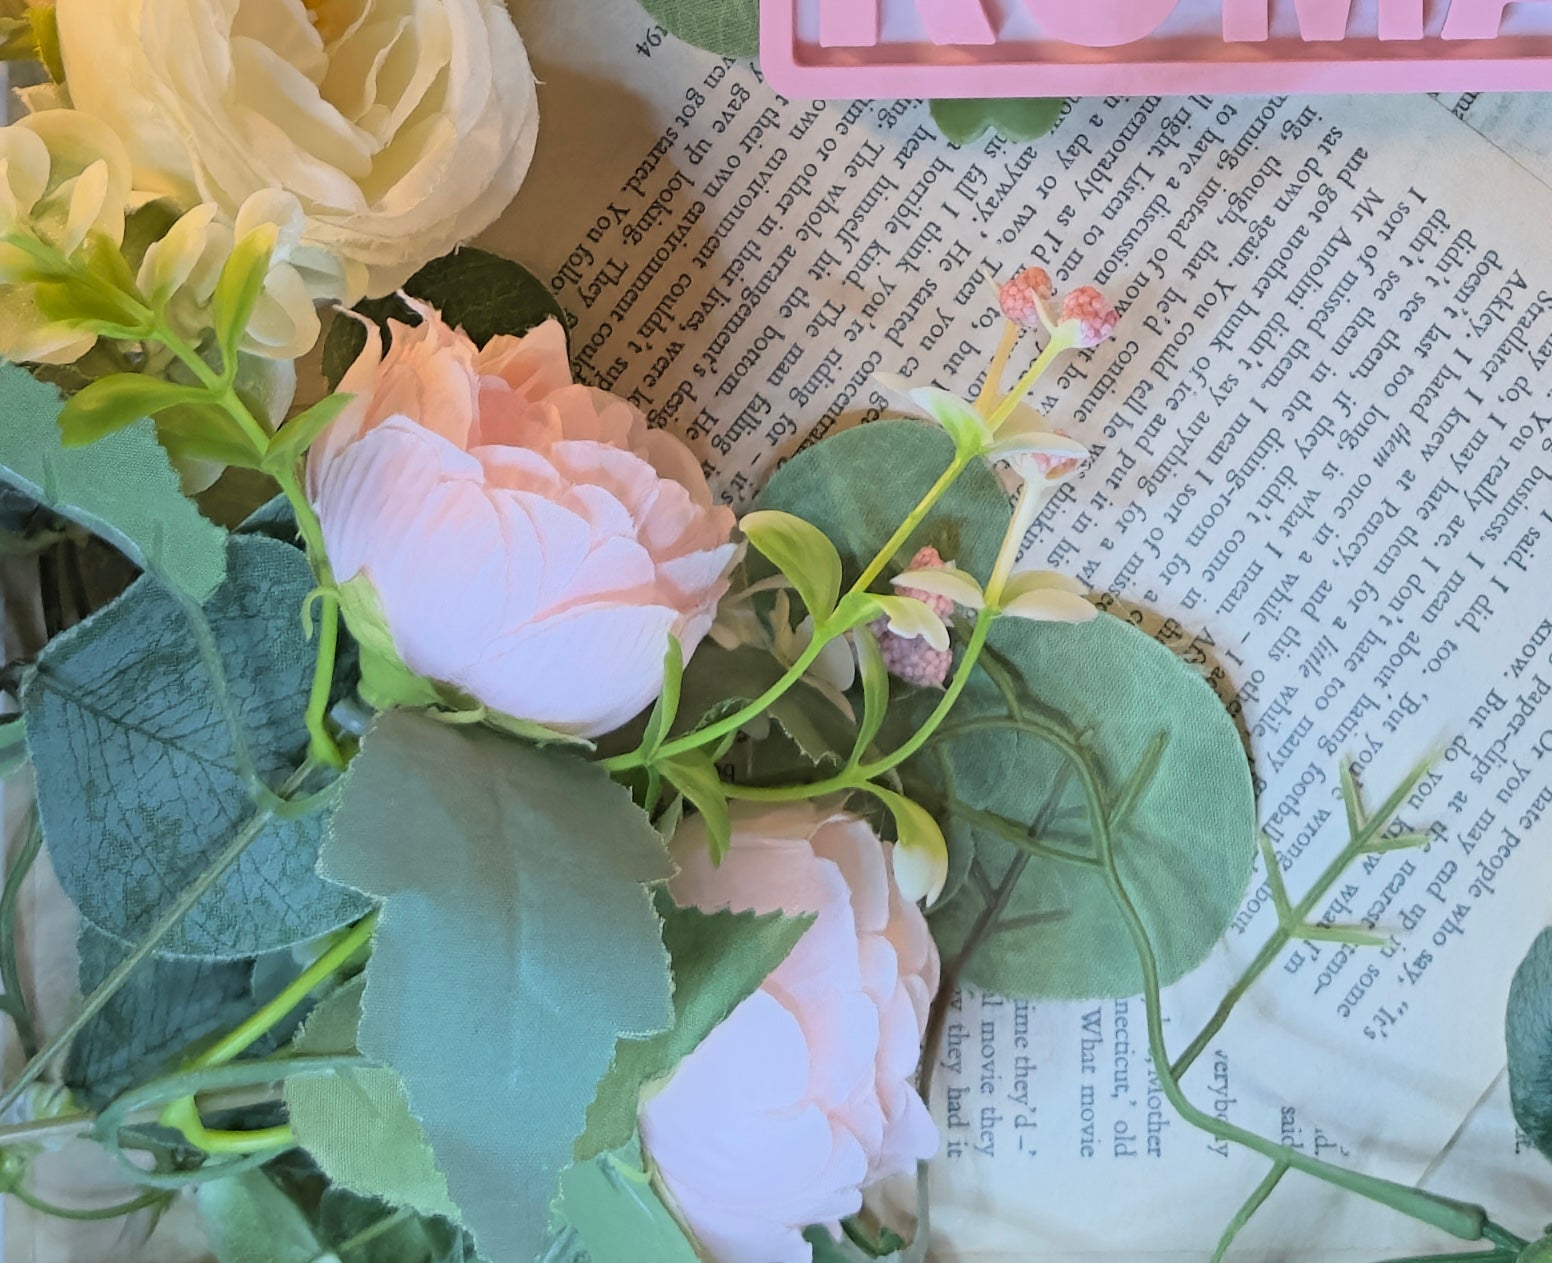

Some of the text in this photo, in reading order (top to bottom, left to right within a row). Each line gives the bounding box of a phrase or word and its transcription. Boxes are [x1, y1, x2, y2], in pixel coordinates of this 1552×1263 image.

[584, 125, 679, 245] started. You
[683, 122, 938, 442] hear himself hit the bottom. He
[1135, 185, 1386, 498] Mr Antolini didn't say anything
[1431, 902, 1472, 947] who
[1466, 825, 1522, 899] people
[1396, 948, 1434, 987] say,
[938, 1022, 972, 1160] they had it
[972, 1018, 1004, 1159] movie they
[1079, 1005, 1105, 1159] What movie
